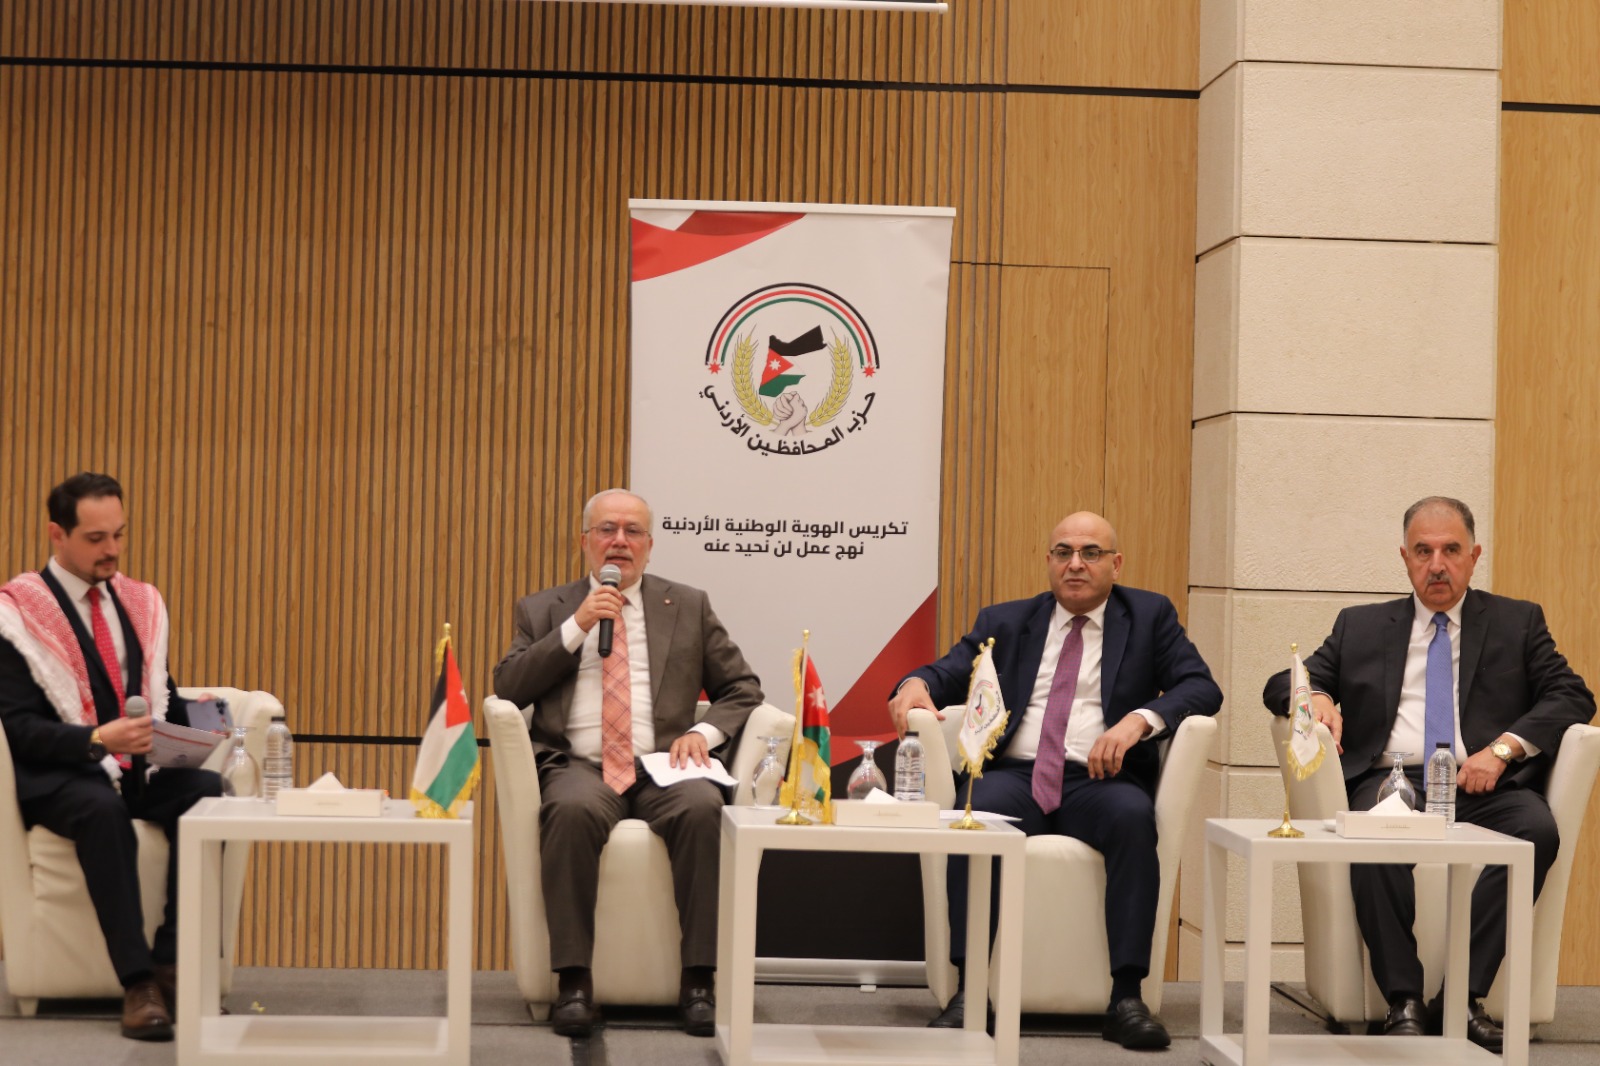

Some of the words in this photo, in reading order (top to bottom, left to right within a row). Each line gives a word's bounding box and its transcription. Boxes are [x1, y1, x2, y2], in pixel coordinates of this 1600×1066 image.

[698, 384, 751, 438] الأردني
[846, 391, 876, 431] حزب
[746, 425, 845, 457] المحافظين
[662, 514, 720, 536] الأردنية
[724, 517, 787, 537] الوطنية
[791, 519, 844, 539] الهوية
[848, 520, 909, 540] تكريس
[703, 538, 731, 553] عنه
[734, 539, 770, 557] نحيد
[773, 540, 792, 558] لن
[796, 540, 831, 558] عمل
[834, 540, 865, 560] نهج
